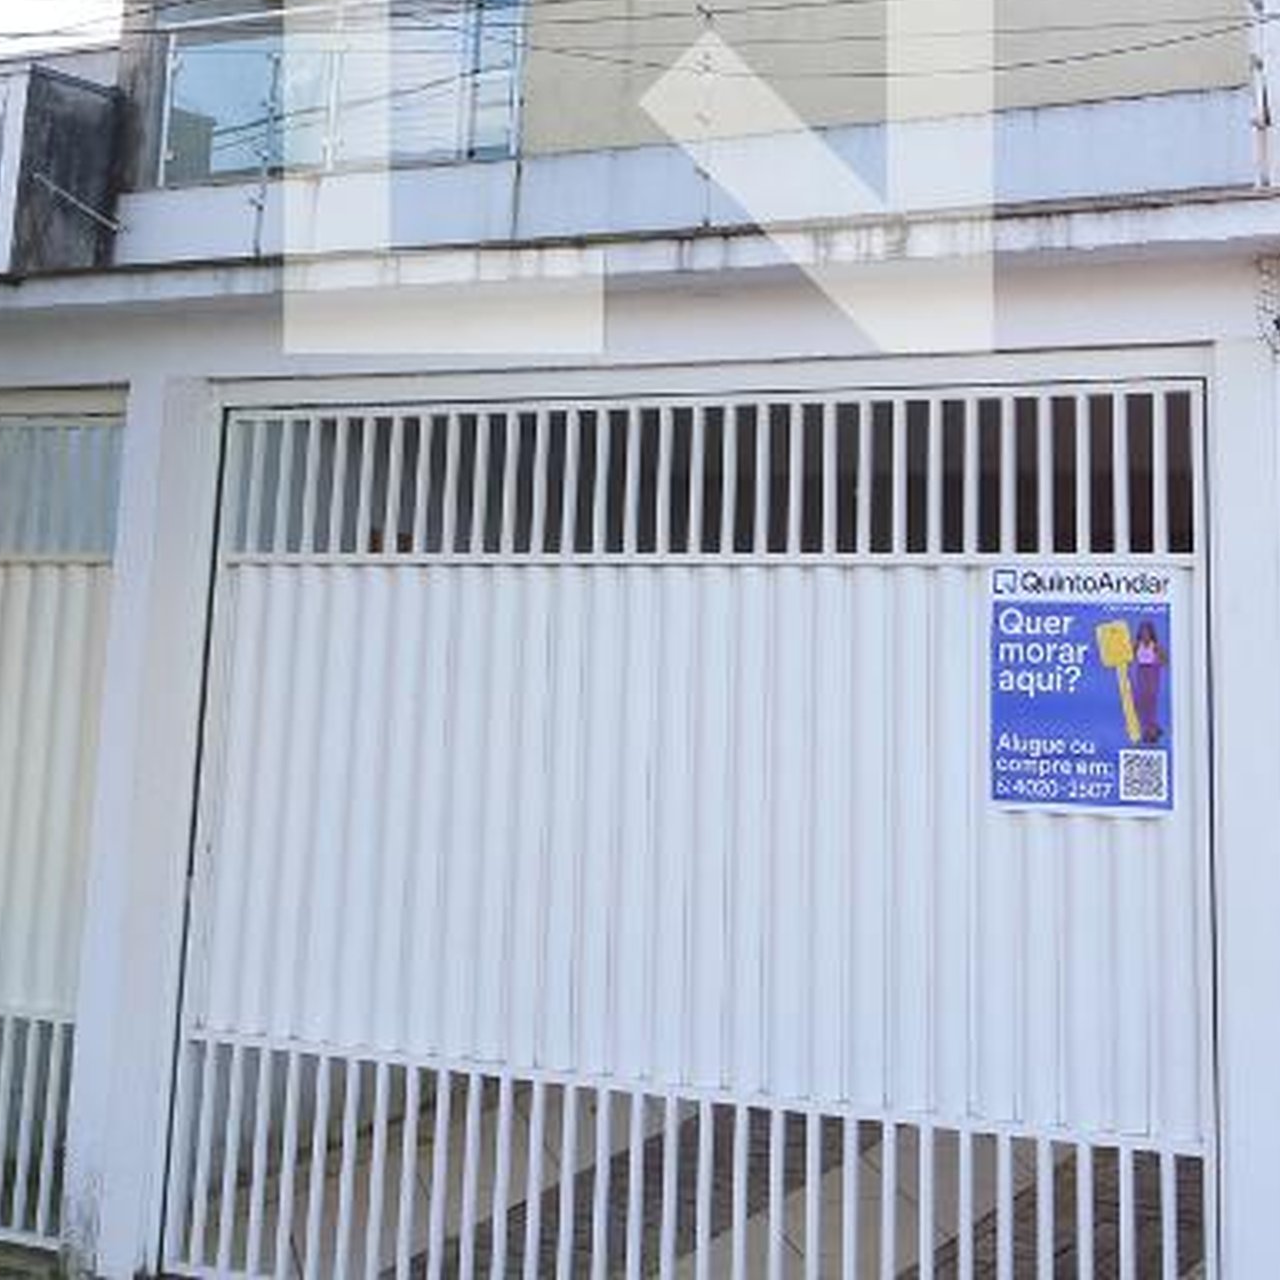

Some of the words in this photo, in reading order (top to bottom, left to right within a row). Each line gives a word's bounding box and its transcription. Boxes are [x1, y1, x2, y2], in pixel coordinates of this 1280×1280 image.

[1020, 571, 1169, 595] QuintoAndar
[998, 607, 1074, 635] Quer
[998, 641, 1088, 665] morar
[998, 666, 1082, 698] aqui?
[996, 732, 1066, 757] Alugue
[995, 757, 1072, 777] compre
